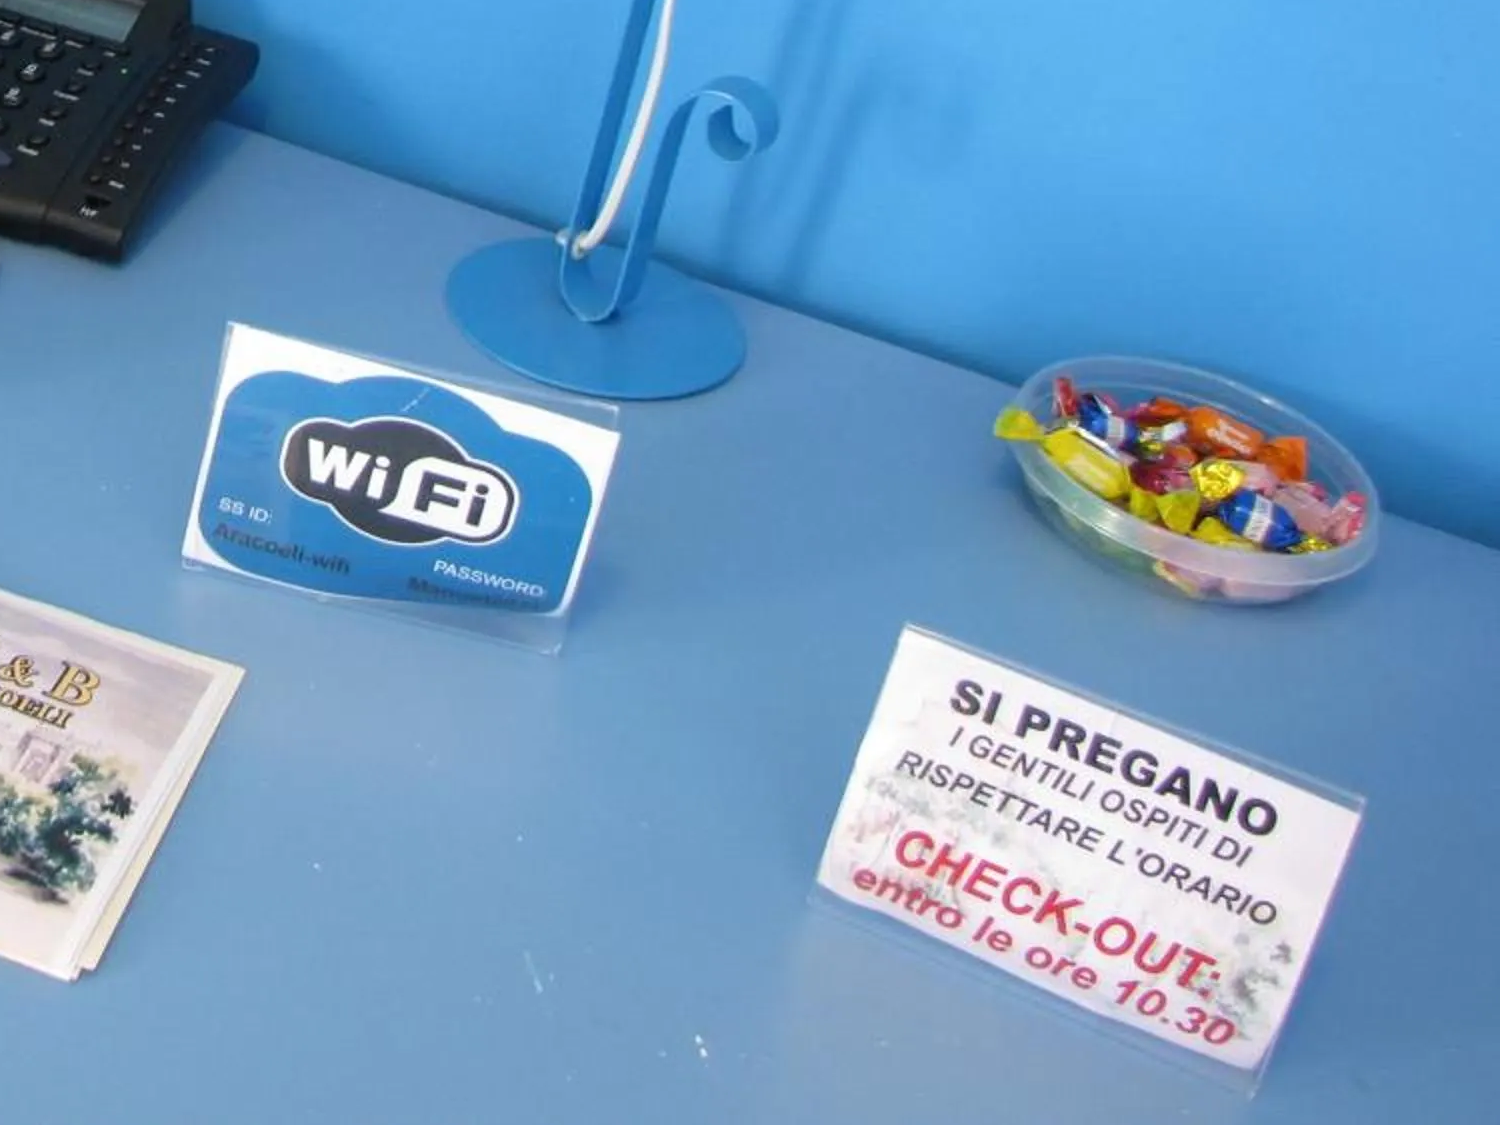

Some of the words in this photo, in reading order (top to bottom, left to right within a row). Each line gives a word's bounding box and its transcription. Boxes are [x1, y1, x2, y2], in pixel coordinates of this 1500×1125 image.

[218, 496, 245, 516] SS
[42, 660, 101, 707] B
[950, 678, 1002, 726] SI
[1016, 704, 1278, 836] PREGANO
[895, 751, 1102, 851] RISPETTARE
[1107, 838, 1278, 926] L'ORARIO
[949, 726, 964, 747] I
[969, 733, 1095, 801] GENTILI
[1100, 788, 1210, 850] OSPITI
[1213, 835, 1254, 868] DI
[854, 867, 965, 930] entro
[972, 916, 1014, 954] le
[1024, 946, 1099, 991] ore
[1114, 980, 1237, 1046] 10.30
[895, 830, 1221, 999] CHECK-OUT:
